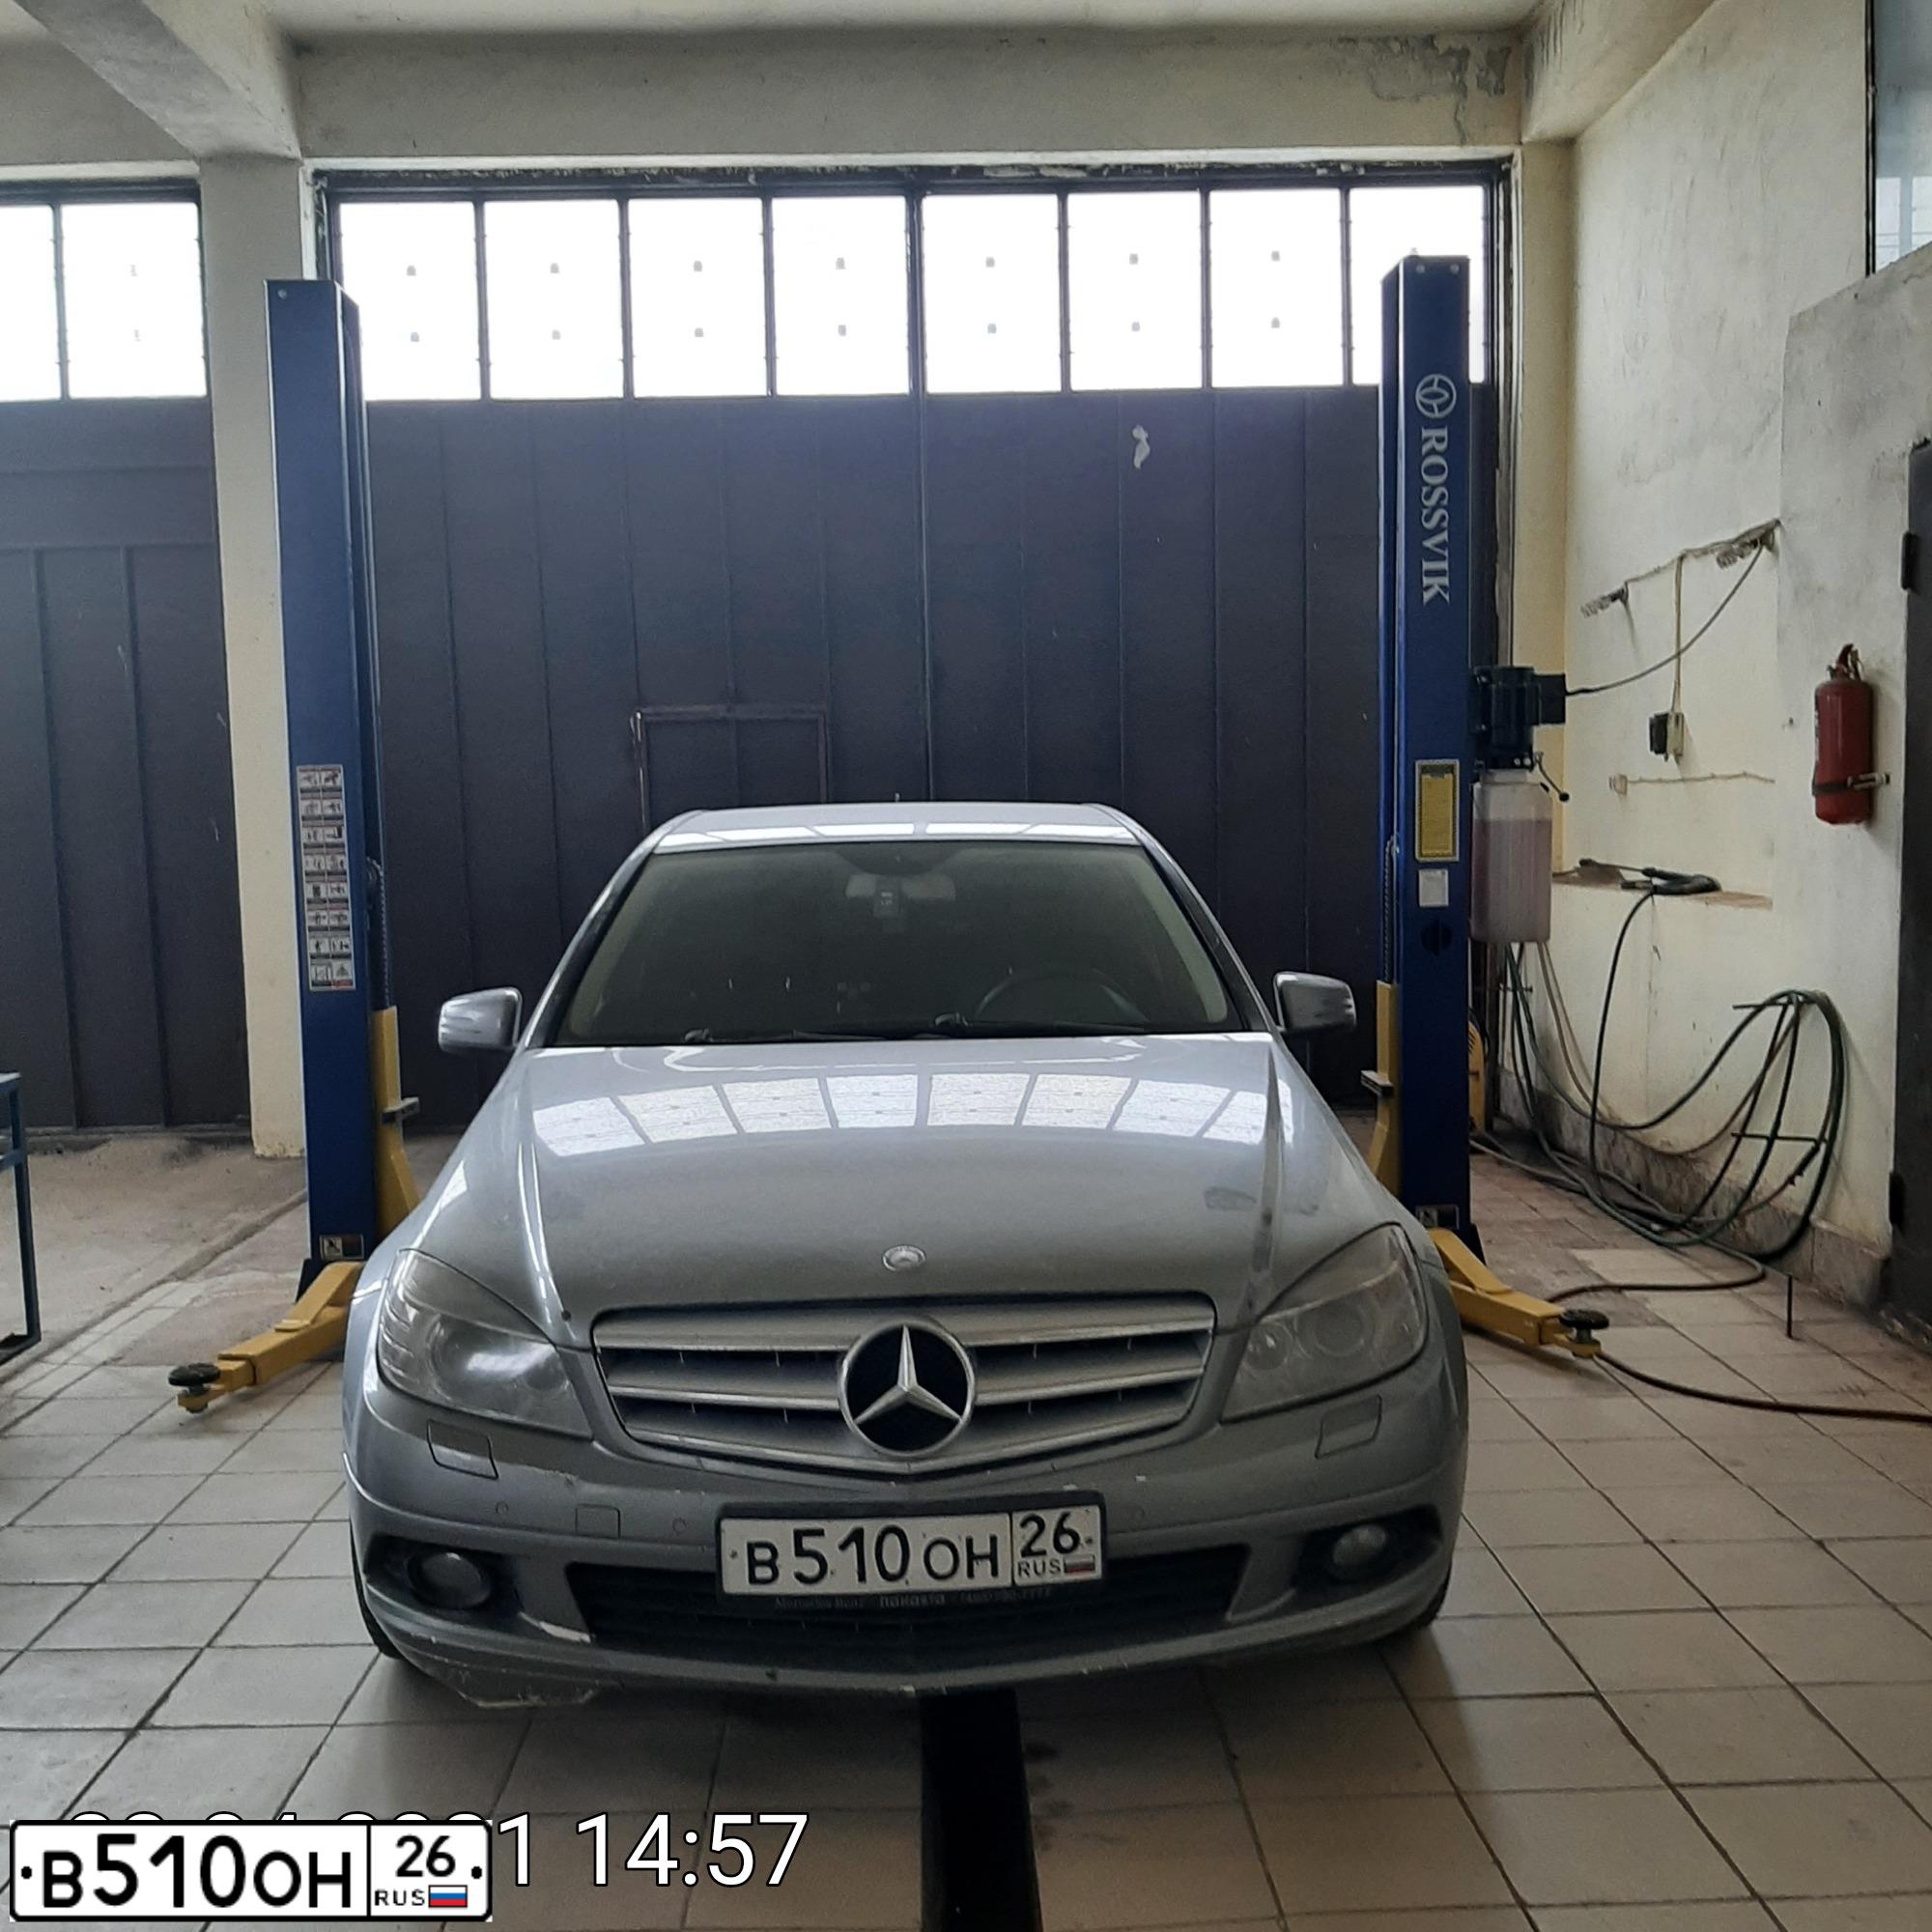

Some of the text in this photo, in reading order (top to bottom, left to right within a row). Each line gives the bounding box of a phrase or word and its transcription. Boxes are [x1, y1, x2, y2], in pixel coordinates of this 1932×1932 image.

[1421, 426, 1450, 606] ROSSVIK
[1020, 1512, 1080, 1558] 26
[1017, 1559, 1062, 1577] RUS
